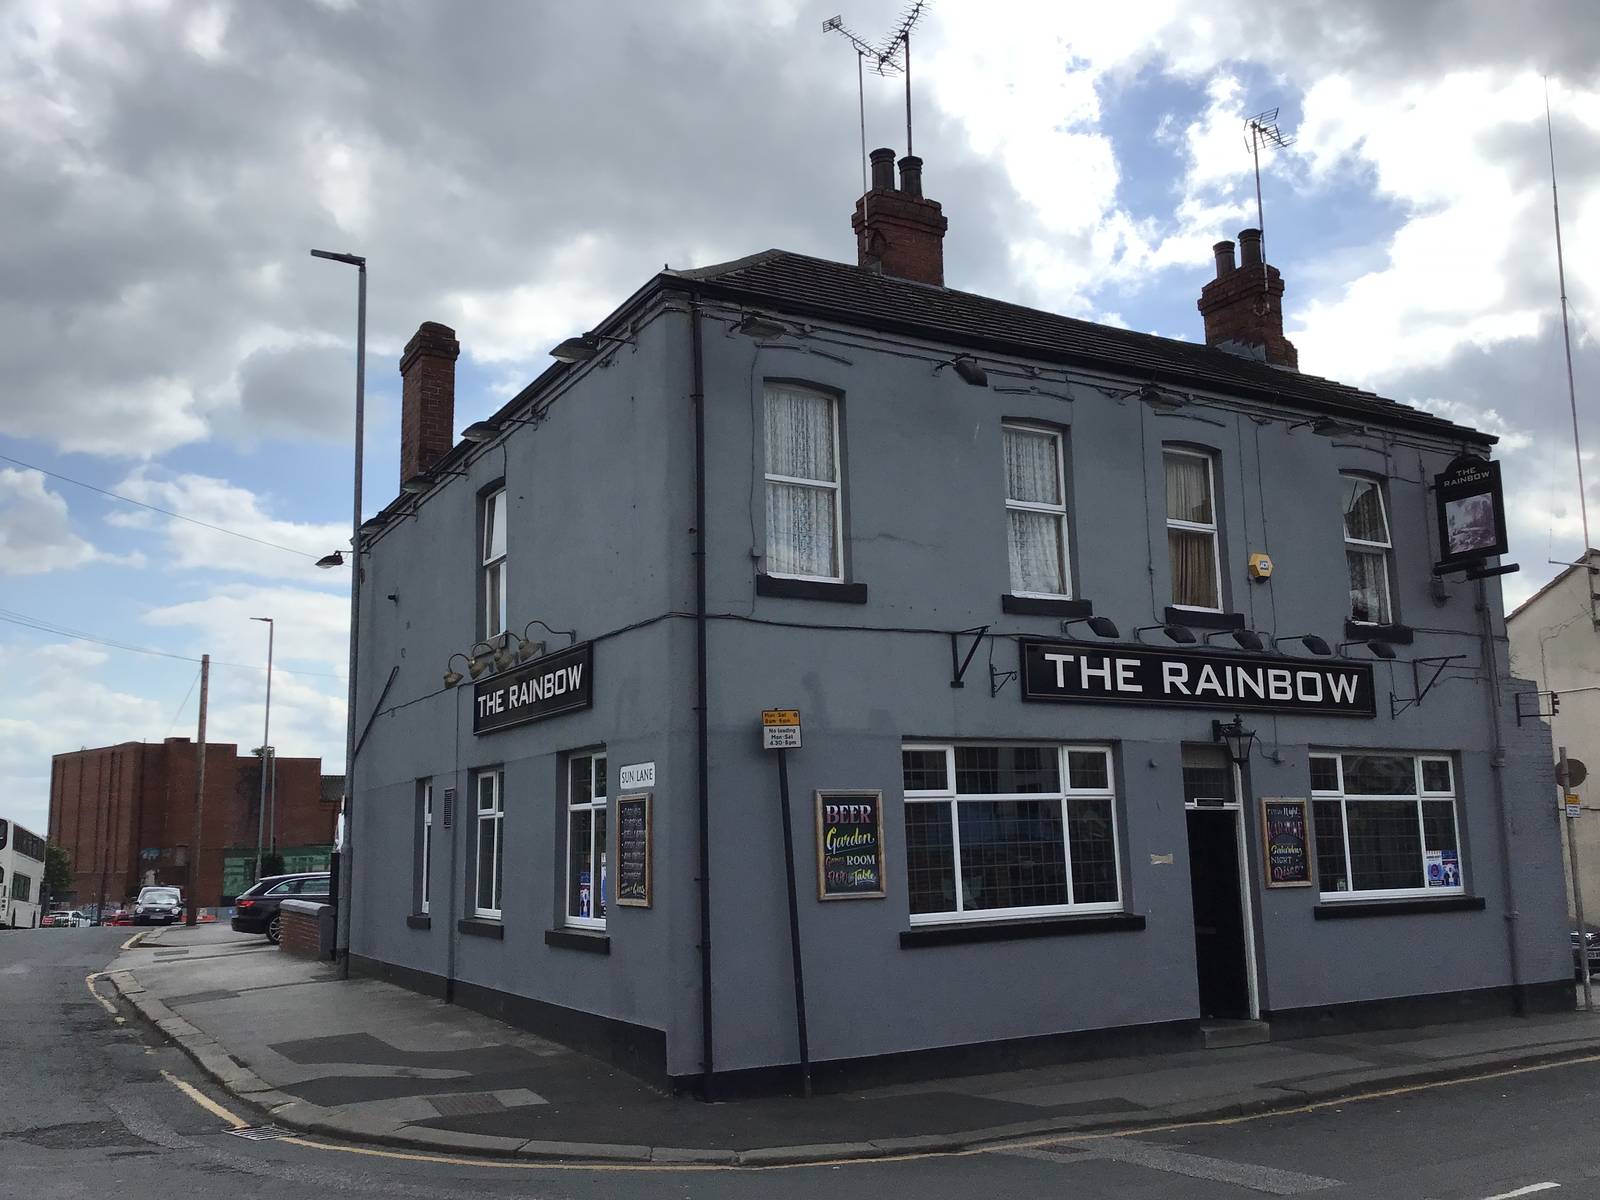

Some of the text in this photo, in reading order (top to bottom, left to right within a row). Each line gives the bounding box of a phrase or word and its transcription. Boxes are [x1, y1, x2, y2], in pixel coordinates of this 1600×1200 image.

[1443, 471, 1490, 488] RAINBOW
[1456, 466, 1476, 477] THE
[1044, 653, 1359, 704] THE RAINBOW
[477, 663, 583, 718] THE RAINBOW
[621, 768, 653, 784] SUN LANE
[825, 804, 872, 824] BEER
[826, 826, 875, 855] Garden
[846, 854, 876, 866] ROOM
[851, 868, 876, 886] Table
